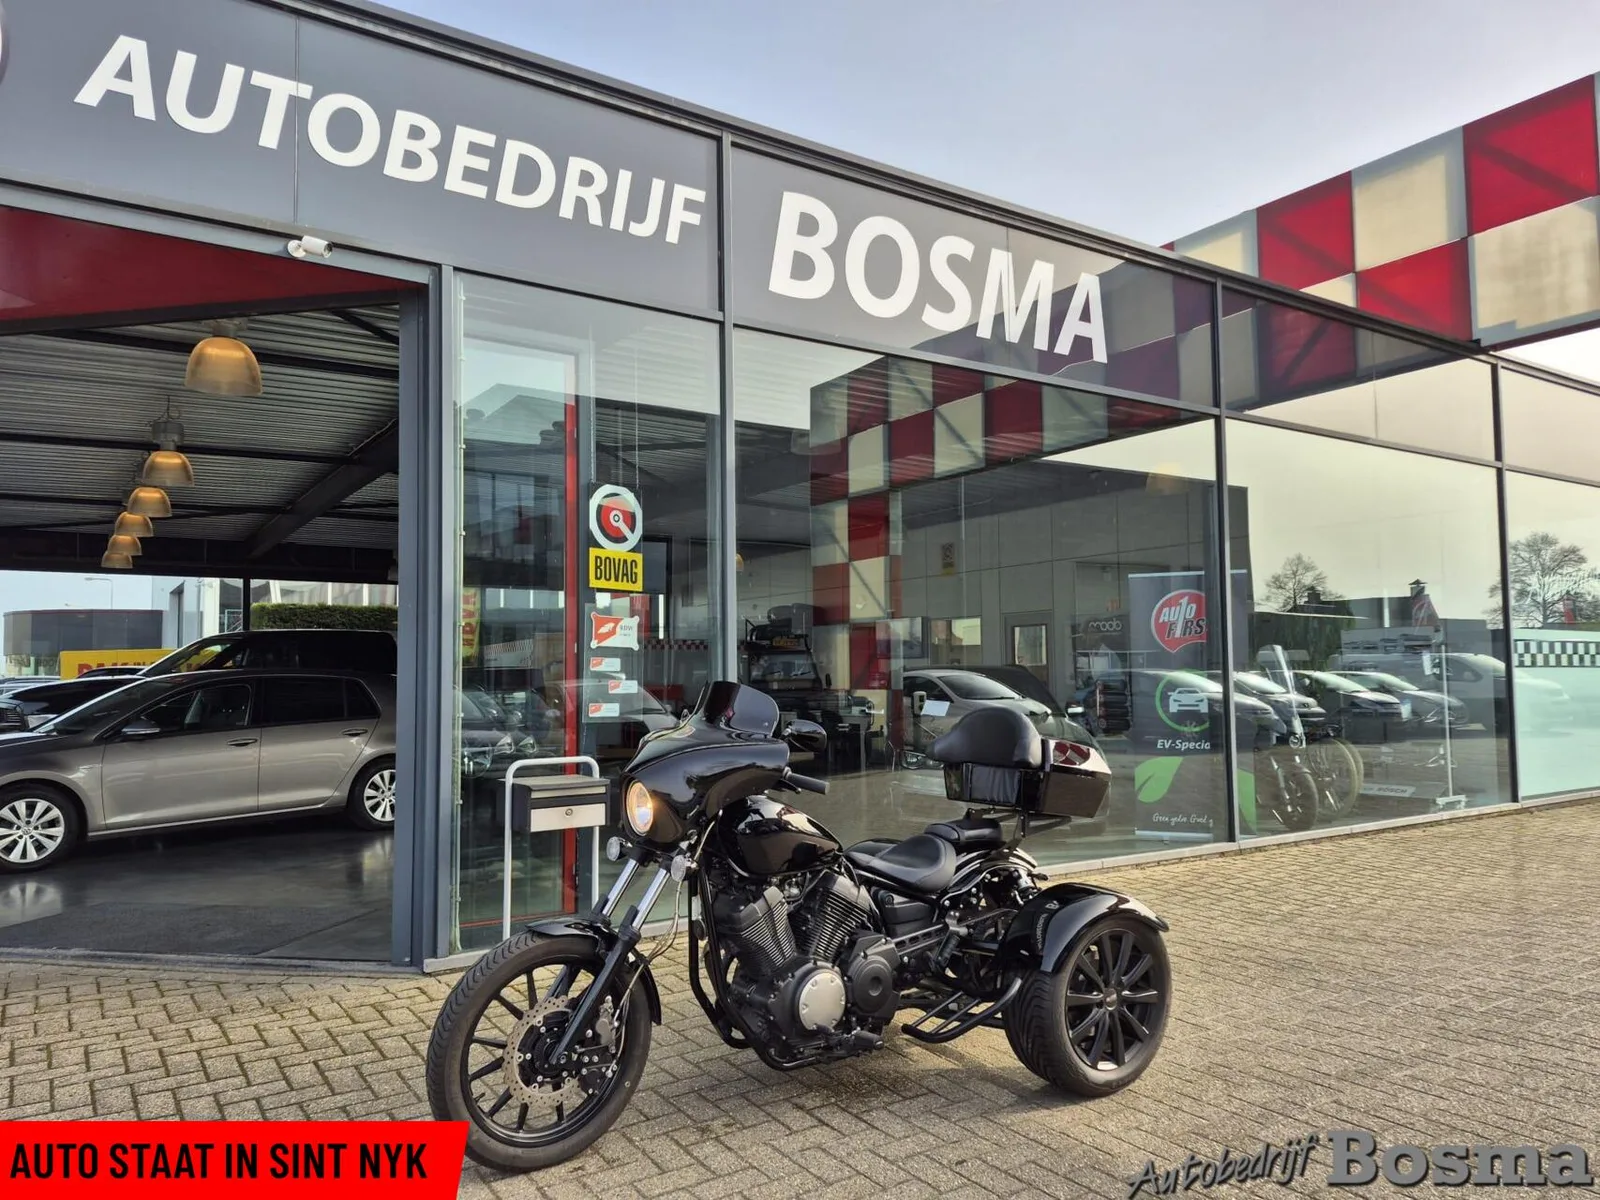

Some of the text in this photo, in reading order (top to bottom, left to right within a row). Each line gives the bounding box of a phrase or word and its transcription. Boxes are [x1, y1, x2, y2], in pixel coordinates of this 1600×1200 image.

[74, 35, 1107, 364] AUTOBEDRIJF BOSMA
[594, 555, 638, 584] BOVAG
